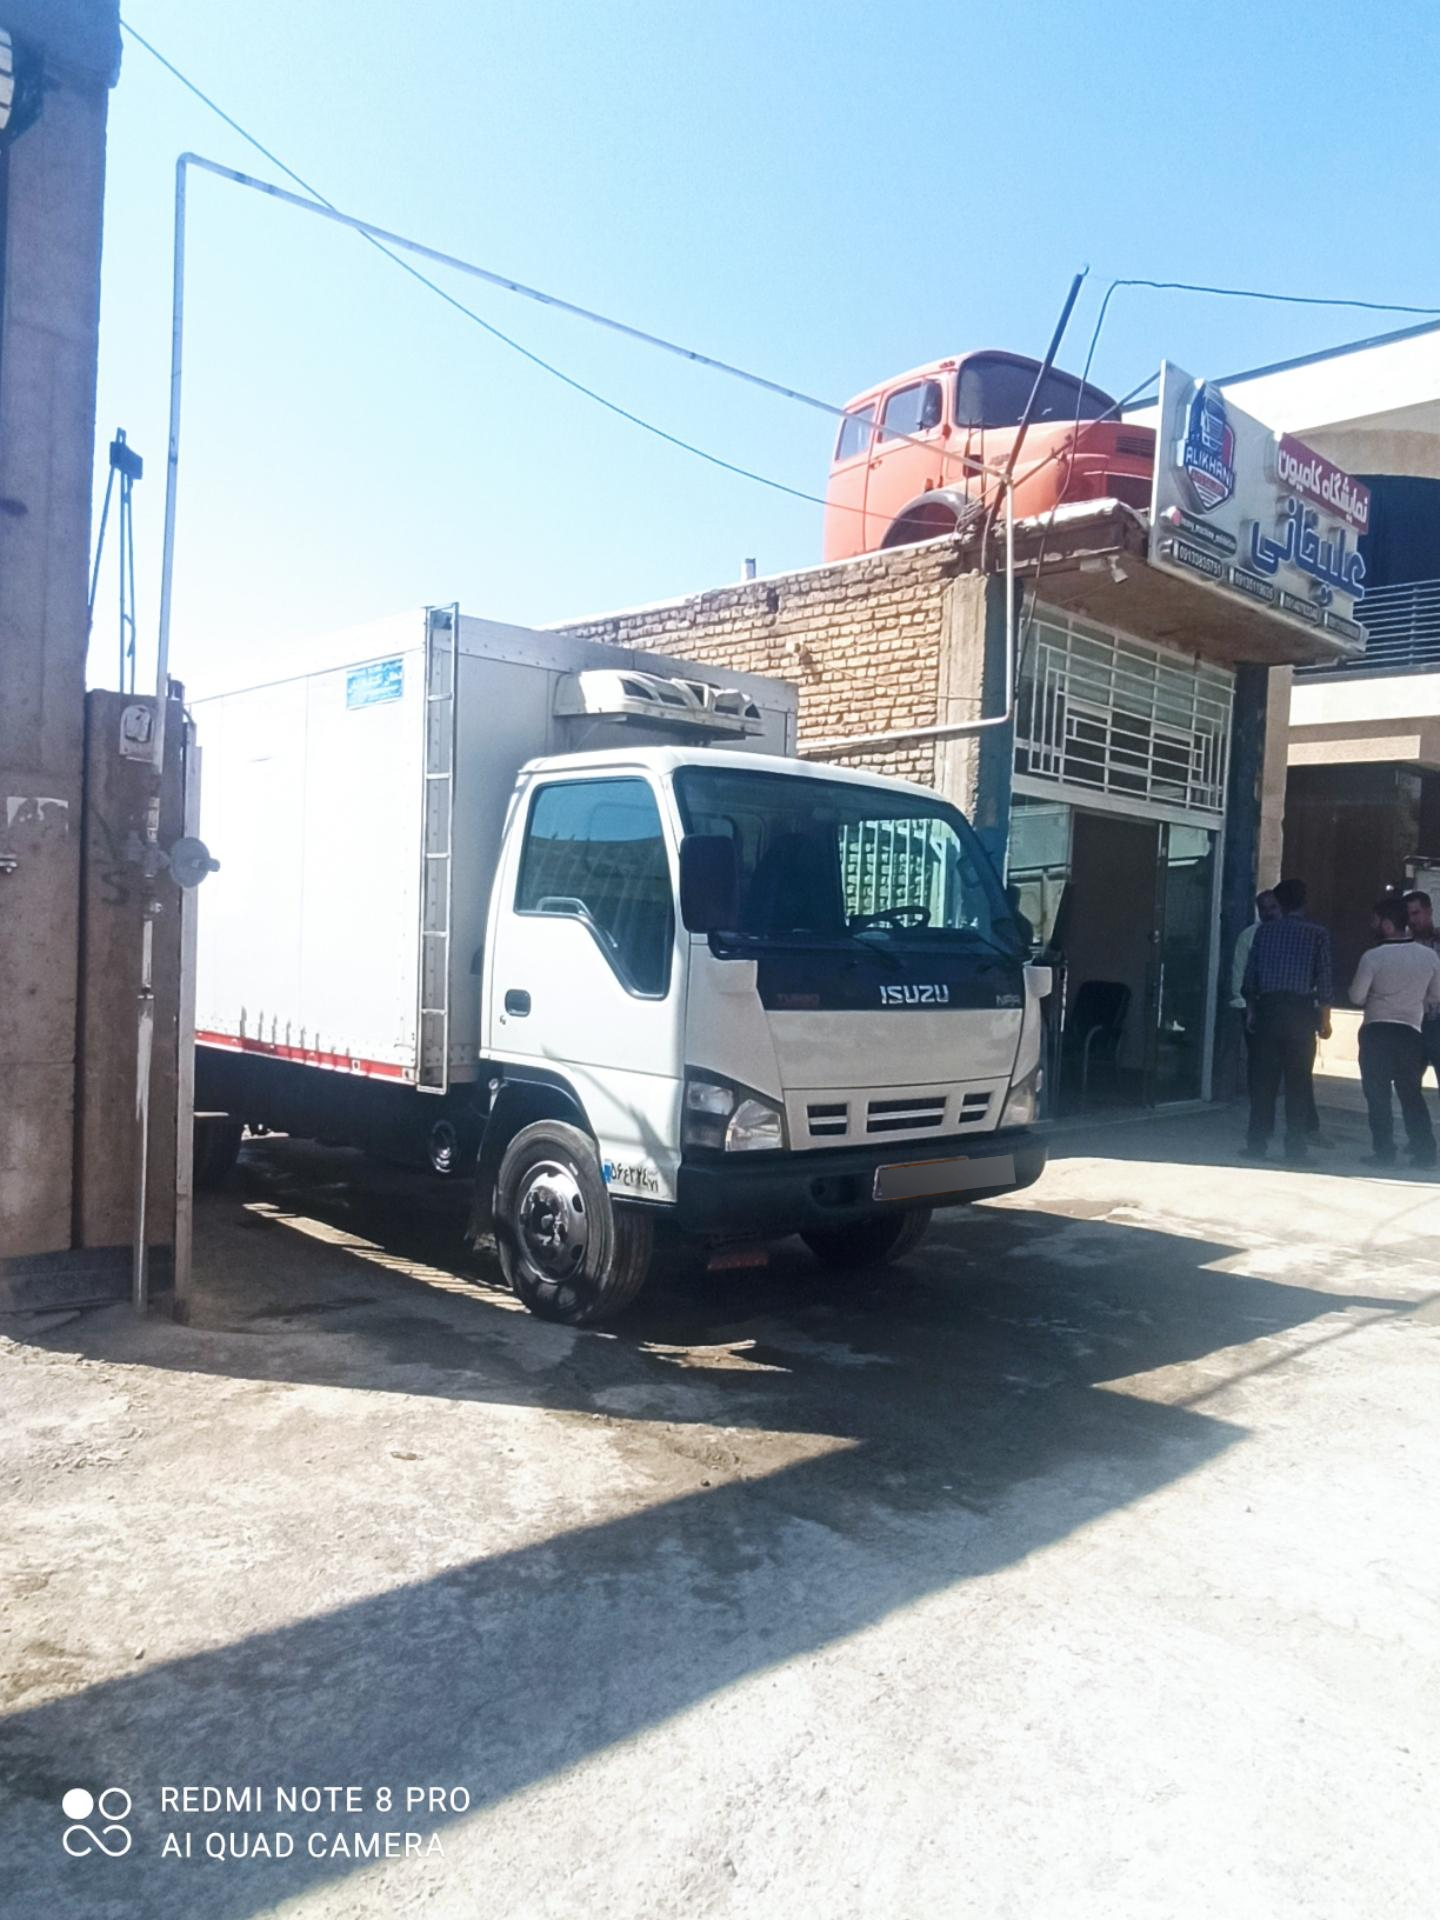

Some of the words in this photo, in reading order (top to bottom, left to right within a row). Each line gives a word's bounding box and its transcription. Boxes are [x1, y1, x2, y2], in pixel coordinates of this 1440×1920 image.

[1278, 450, 1322, 495] کامیون
[1321, 472, 1368, 524] نمایشگاه
[880, 984, 949, 1005] ISUZU
